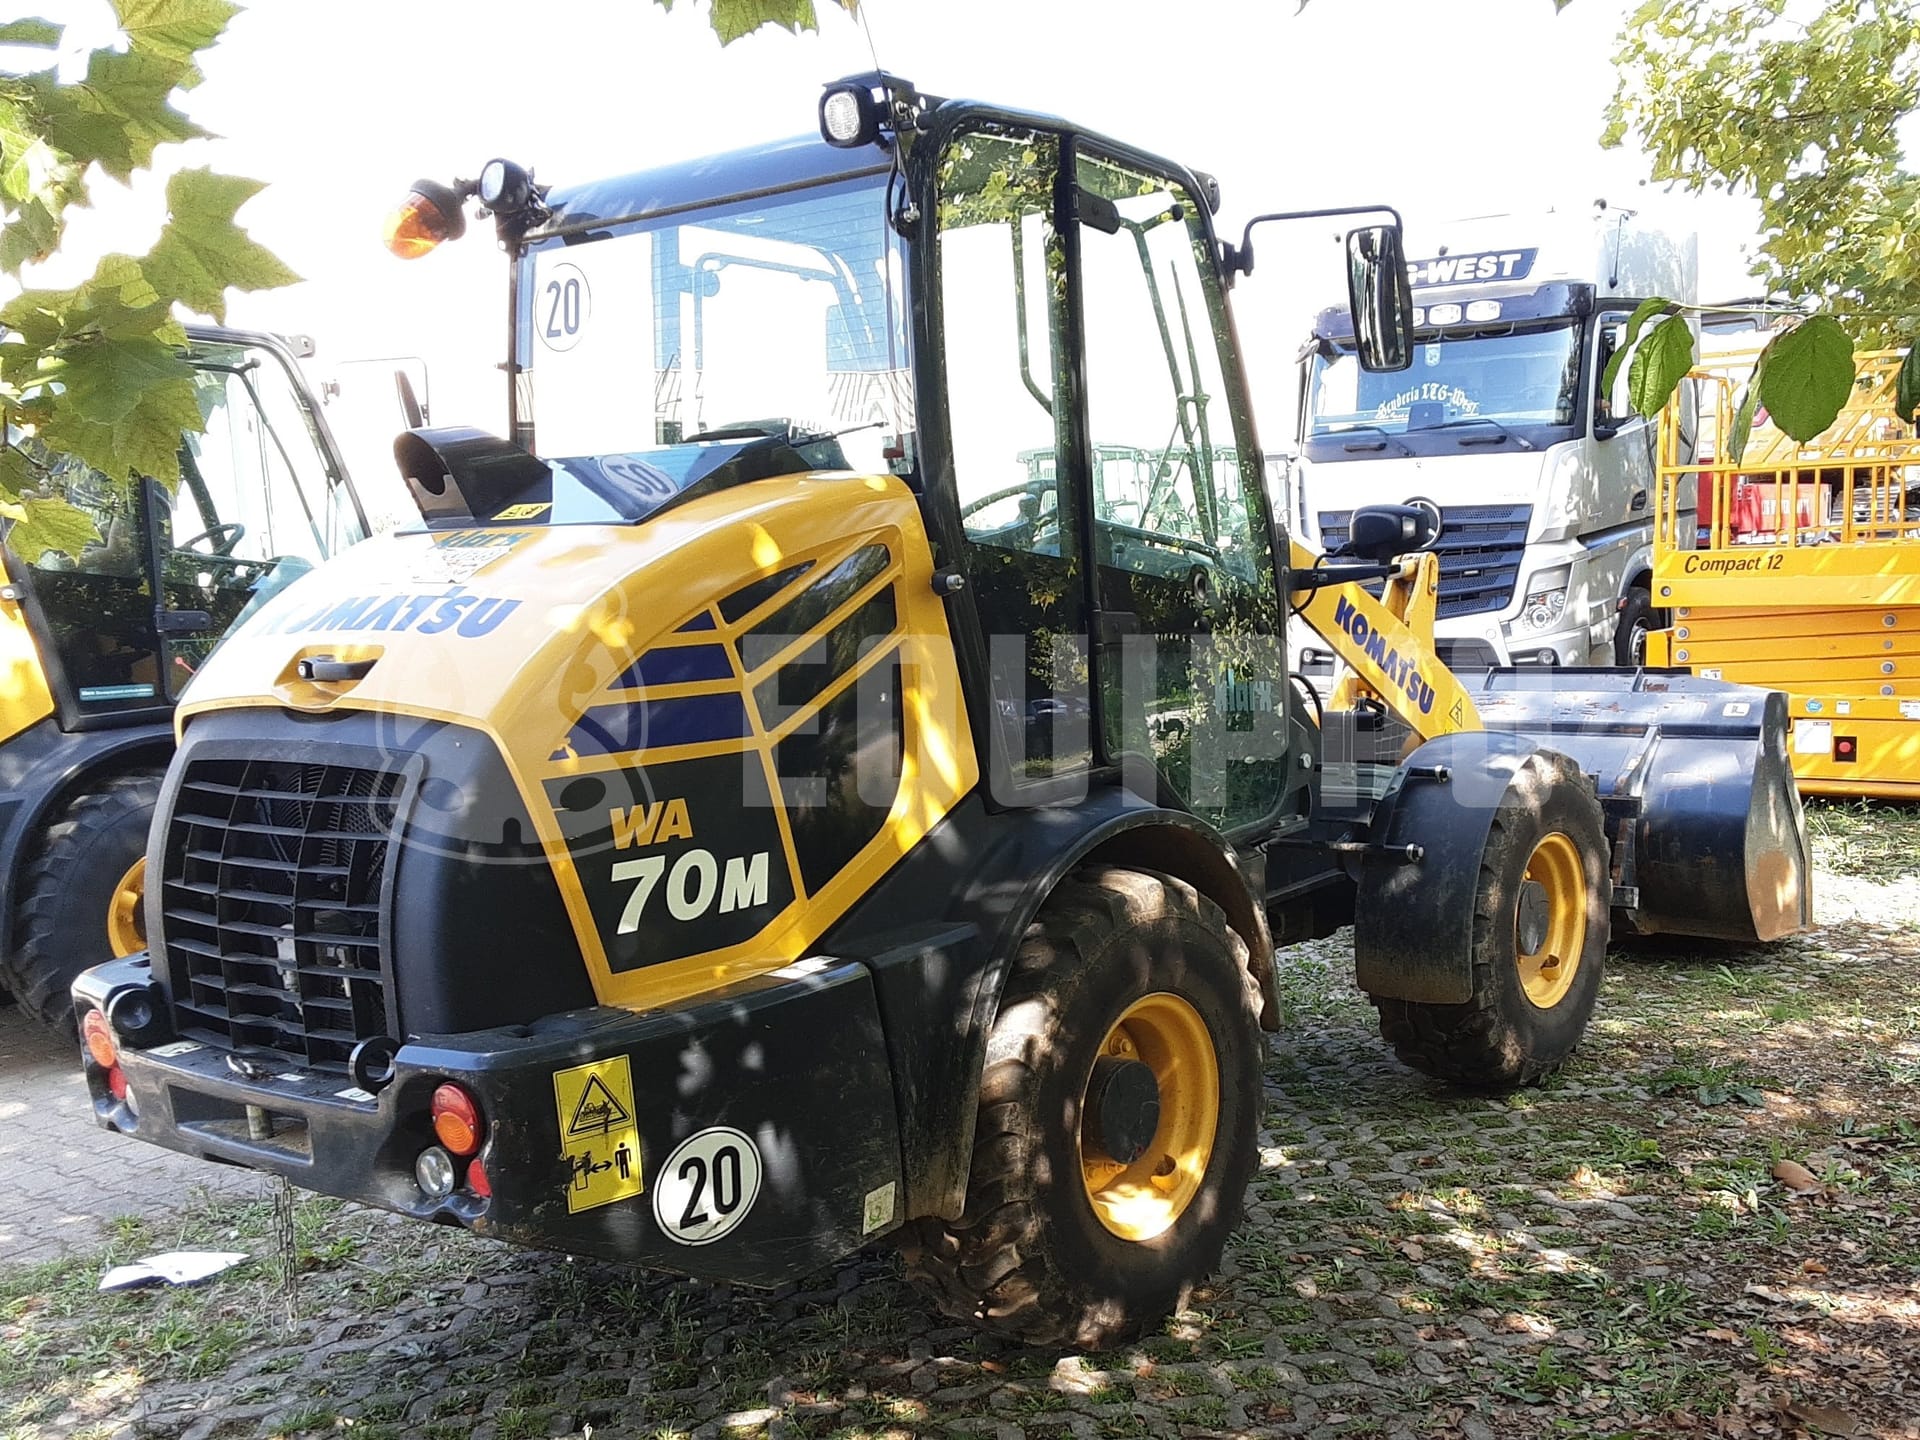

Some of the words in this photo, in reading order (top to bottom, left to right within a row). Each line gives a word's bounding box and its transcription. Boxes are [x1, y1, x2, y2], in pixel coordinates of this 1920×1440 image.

[546, 278, 580, 338] 20
[1684, 554, 1761, 576] Compact
[1767, 554, 1784, 570] 12
[1334, 593, 1436, 714] KOMATSU
[609, 797, 694, 850] WA
[611, 848, 769, 935] 70M
[678, 1145, 742, 1230] 20
